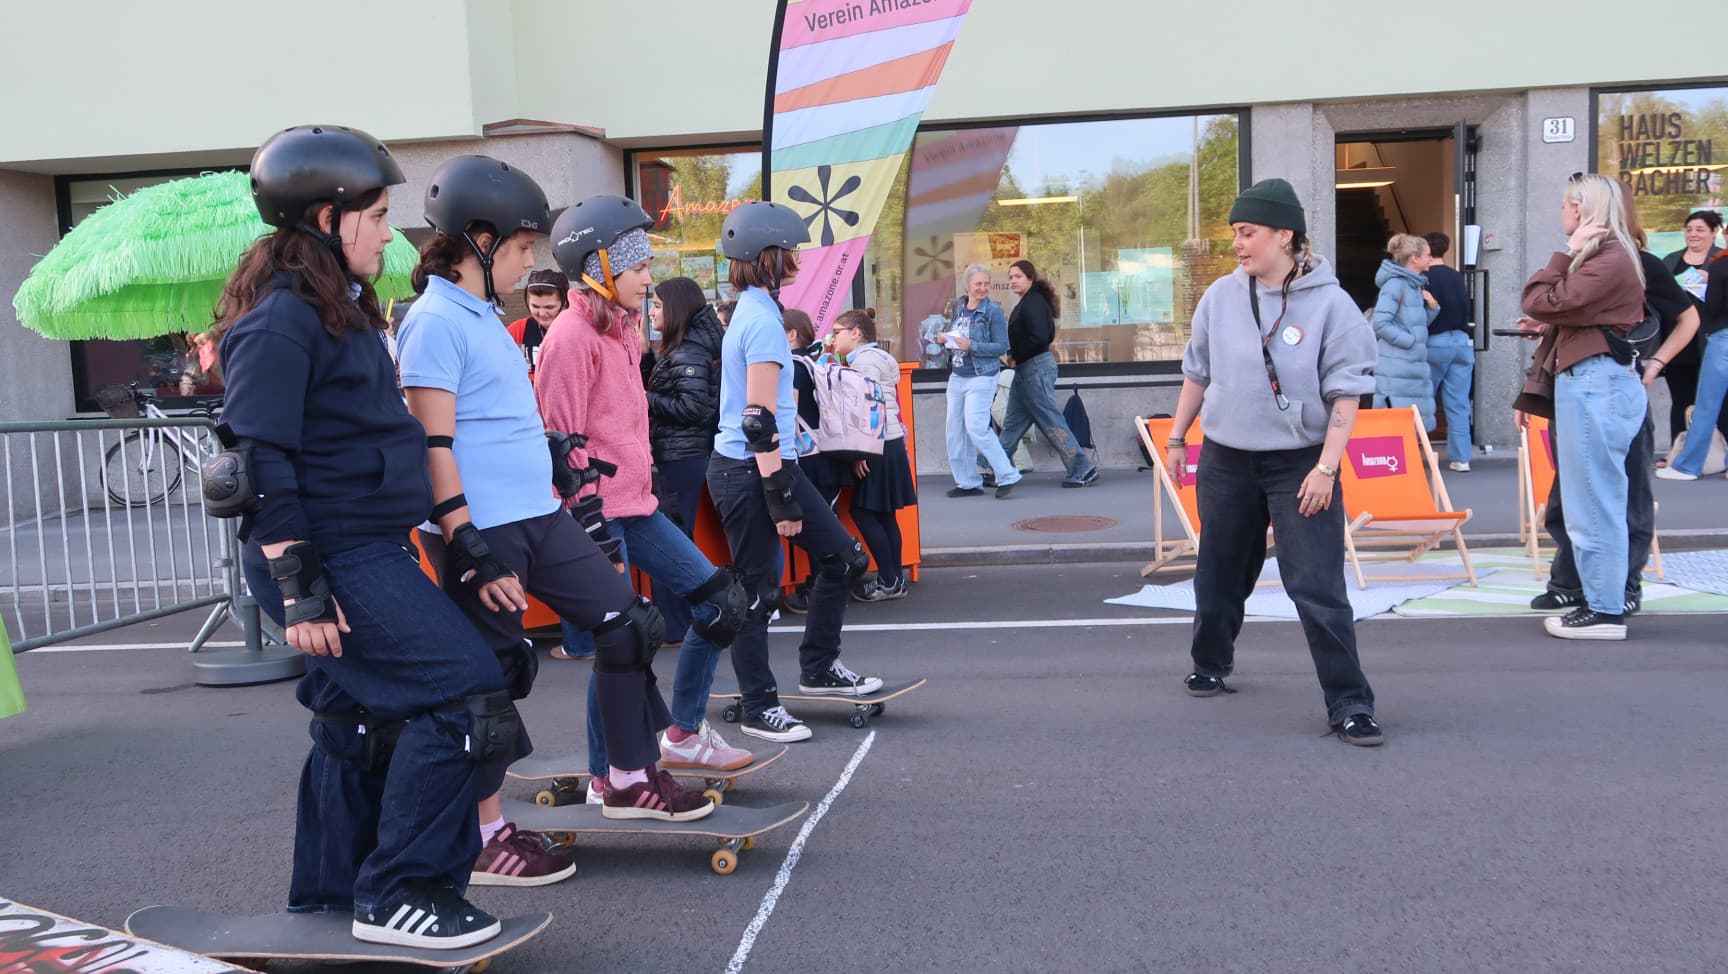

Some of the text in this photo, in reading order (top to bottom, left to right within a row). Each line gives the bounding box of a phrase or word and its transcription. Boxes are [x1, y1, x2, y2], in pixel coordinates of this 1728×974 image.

[805, 2, 864, 32] Verein
[1550, 119, 1568, 135] 31
[1619, 113, 1682, 140] HAUS
[1619, 139, 1712, 168] WELZEN
